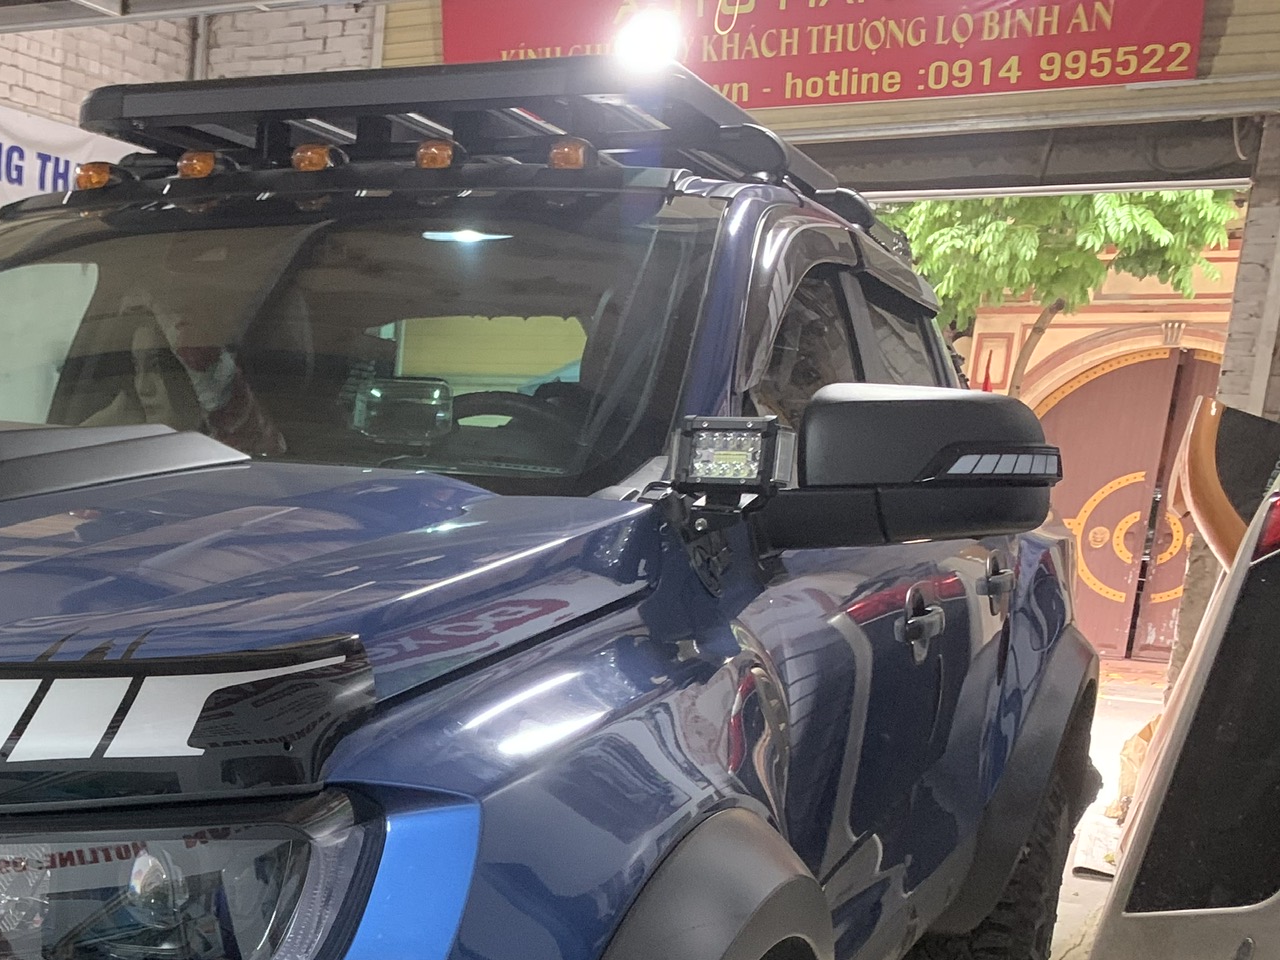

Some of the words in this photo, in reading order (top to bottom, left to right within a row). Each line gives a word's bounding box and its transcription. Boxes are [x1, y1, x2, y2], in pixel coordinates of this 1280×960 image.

[702, 25, 799, 62] KHÁCH
[807, 18, 927, 55] THƯỢNG
[934, 6, 974, 49] LỘ
[1066, 1, 1116, 34] AN
[785, 67, 901, 98] hotline
[1039, 42, 1192, 82] 995522
